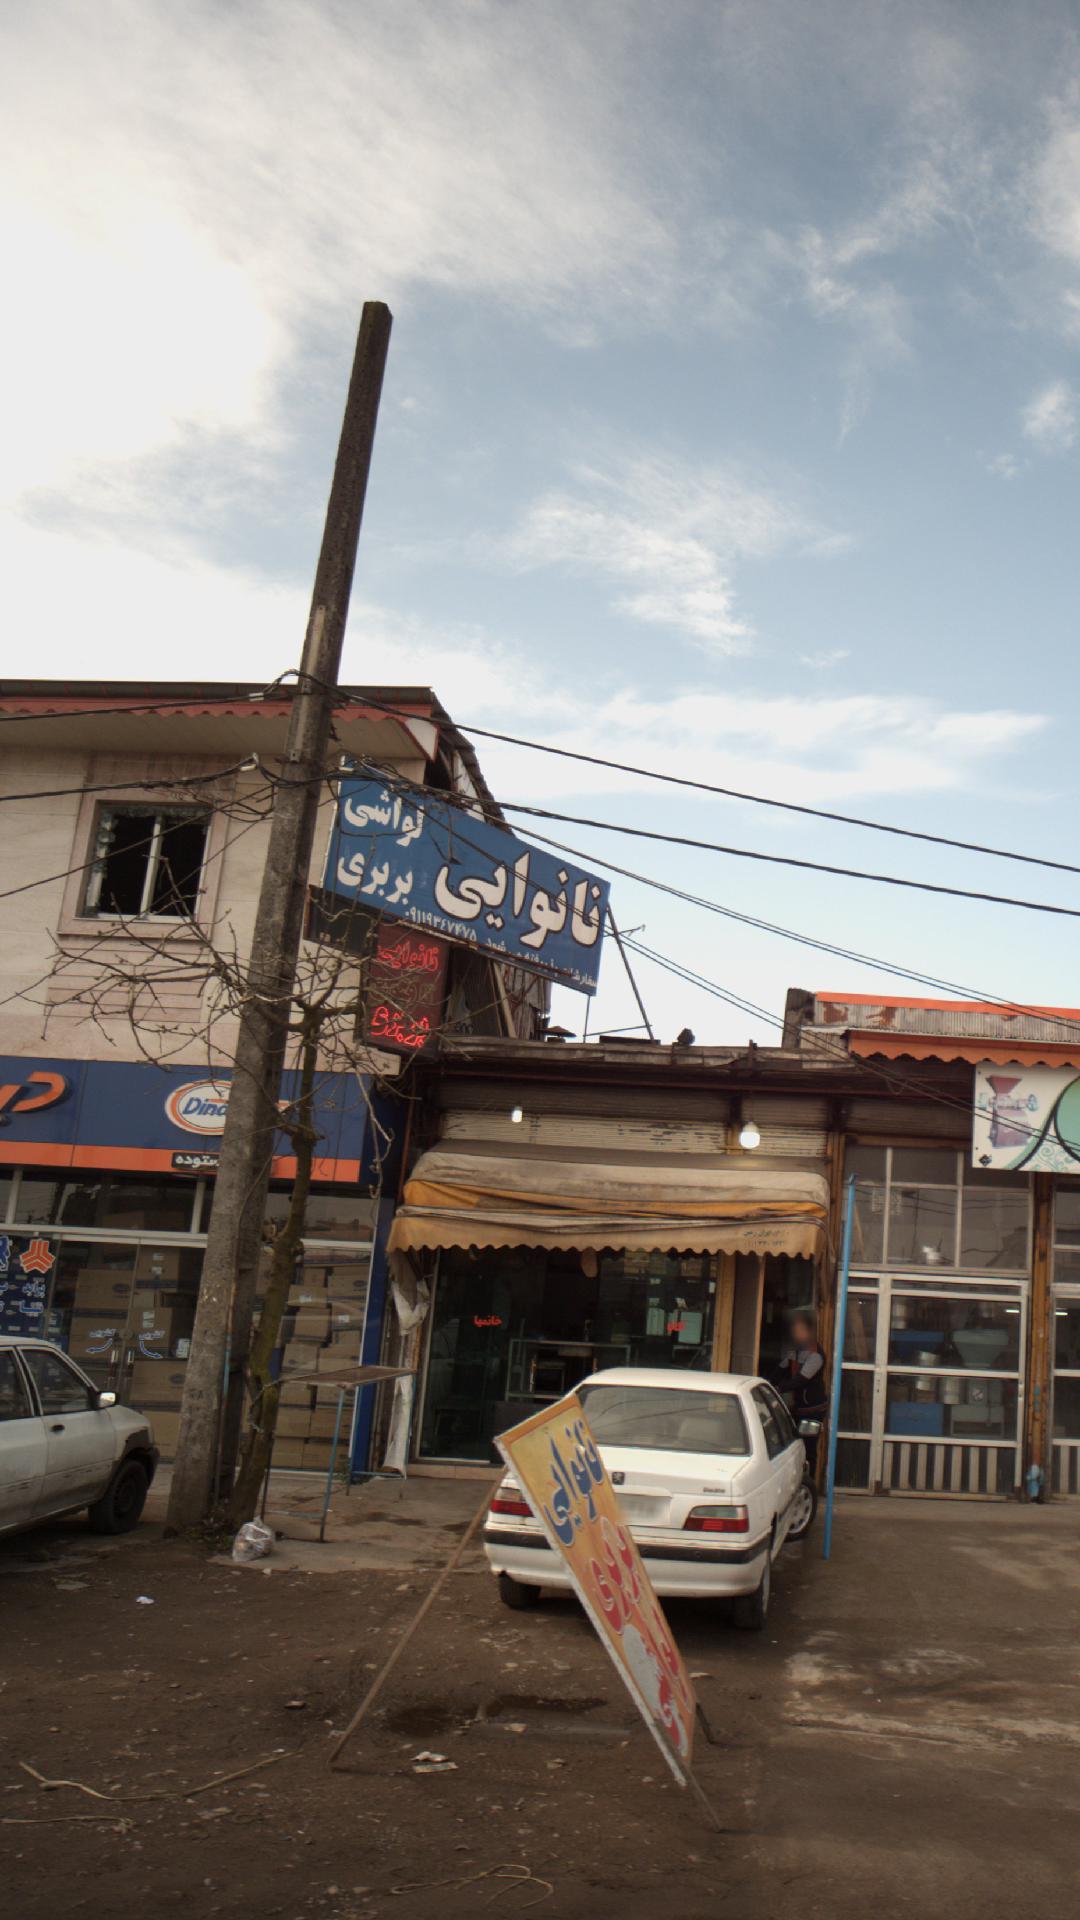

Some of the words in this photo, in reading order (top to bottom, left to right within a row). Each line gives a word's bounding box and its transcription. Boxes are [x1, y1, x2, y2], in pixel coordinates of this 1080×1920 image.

[344, 791, 425, 846] لواشی
[337, 853, 414, 904] بربری
[435, 850, 602, 949] نانوایی
[182, 1096, 229, 1117] Dina
[543, 1419, 603, 1547] نانوایی
